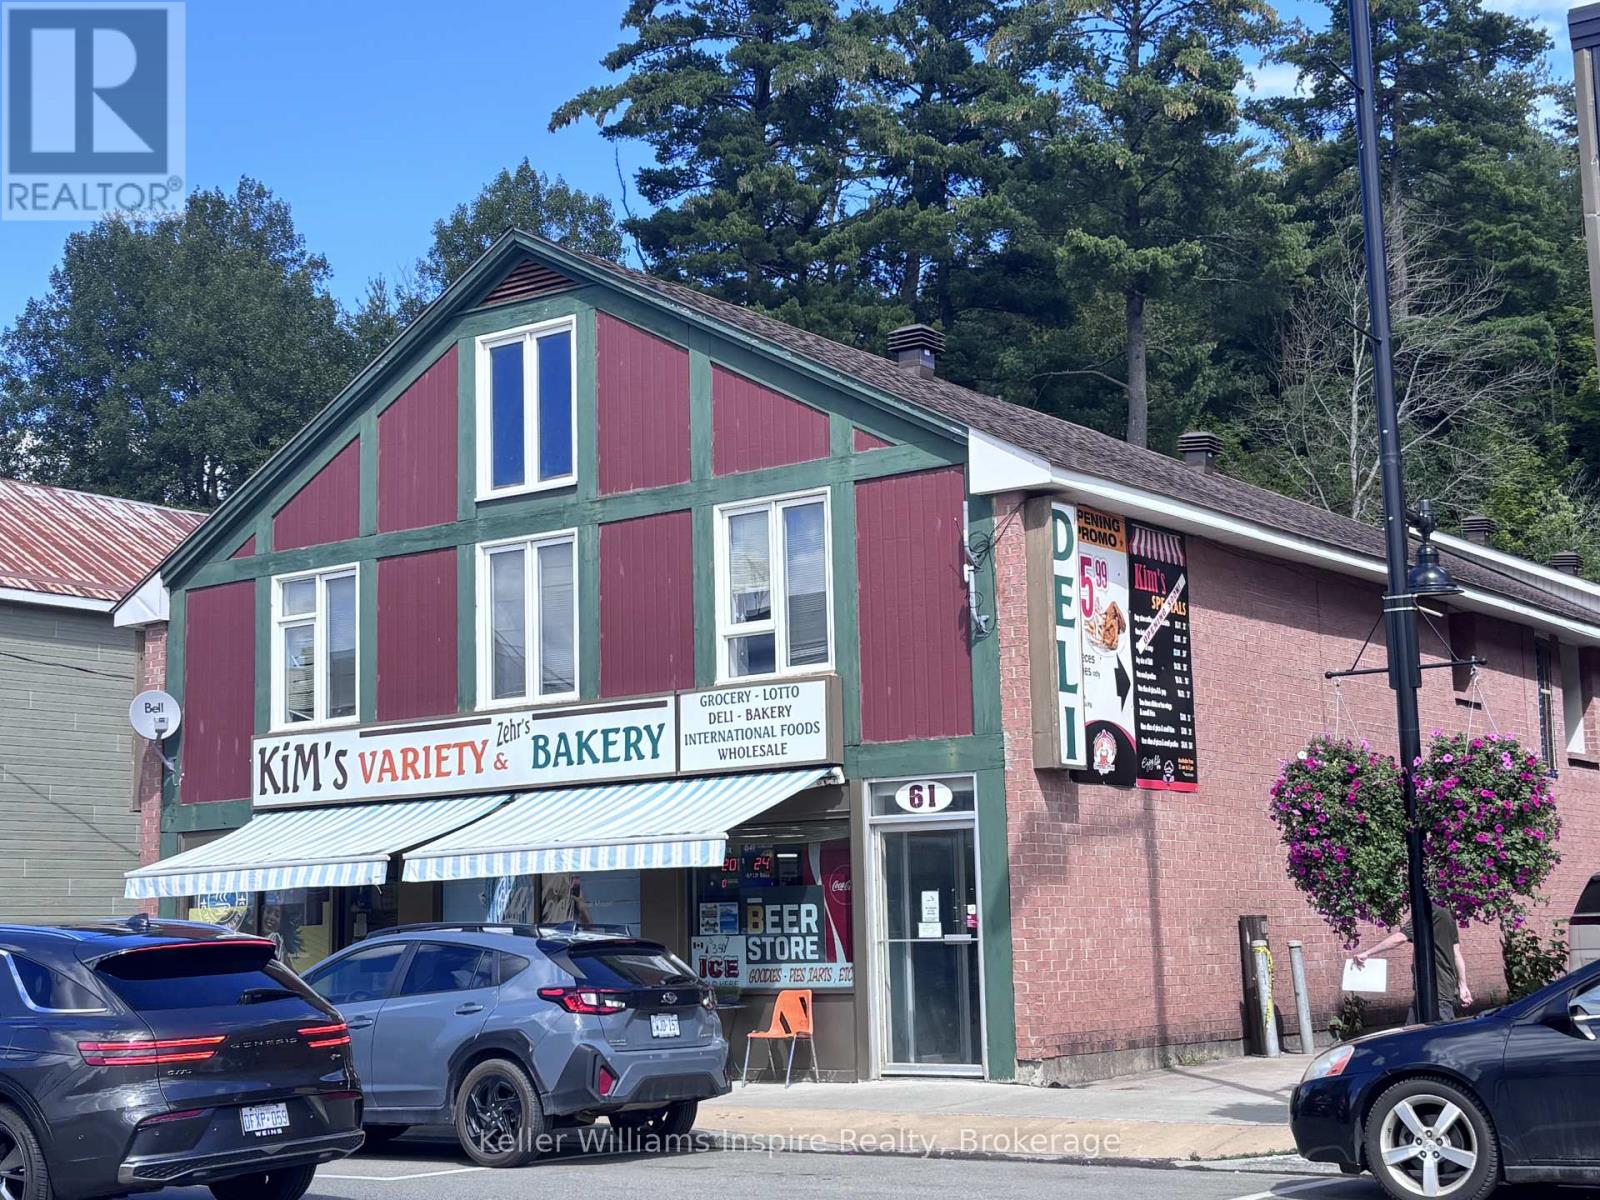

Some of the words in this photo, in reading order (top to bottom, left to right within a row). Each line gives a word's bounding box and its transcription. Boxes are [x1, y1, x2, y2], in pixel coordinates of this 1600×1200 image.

[1077, 510, 1121, 533] PENING
[1135, 563, 1167, 595] Kim's
[1151, 595, 1187, 616] SPEALS
[1051, 509, 1078, 760] DELI
[144, 702, 164, 714] Bell
[700, 690, 752, 708] GROCERY
[763, 685, 800, 701] LOTTO
[708, 710, 734, 725] DELI
[745, 705, 792, 721] BAKERY
[496, 718, 531, 747] Zehr's
[684, 725, 777, 746] INTERNATIONAL
[780, 721, 820, 737] FOODS
[358, 739, 489, 785] VARIETY
[493, 752, 509, 771] &
[531, 723, 666, 769] BAKERY
[717, 742, 788, 761] WHOLESALE
[908, 784, 936, 809] 61
[753, 857, 771, 871] 24
[747, 903, 819, 935] BEER
[747, 935, 819, 962] STORE
[699, 955, 741, 979] ICE
[255, 1128, 282, 1137] WEINS
